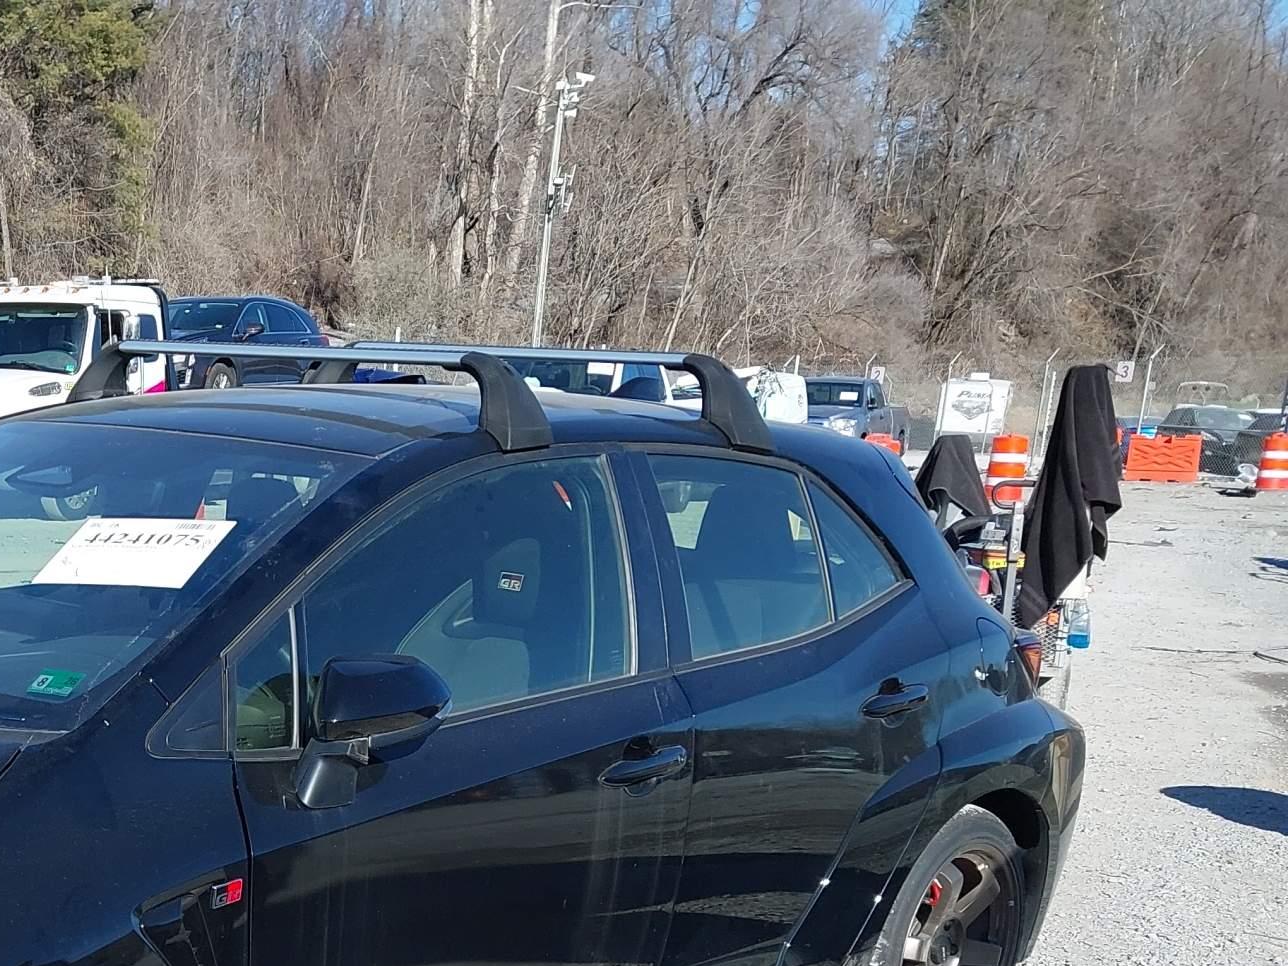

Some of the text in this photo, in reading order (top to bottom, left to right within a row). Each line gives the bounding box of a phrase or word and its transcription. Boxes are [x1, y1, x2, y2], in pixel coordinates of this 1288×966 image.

[1121, 364, 1130, 379] 3
[84, 532, 204, 547] 44241075
[499, 578, 521, 591] GR
[37, 677, 49, 687] 8
